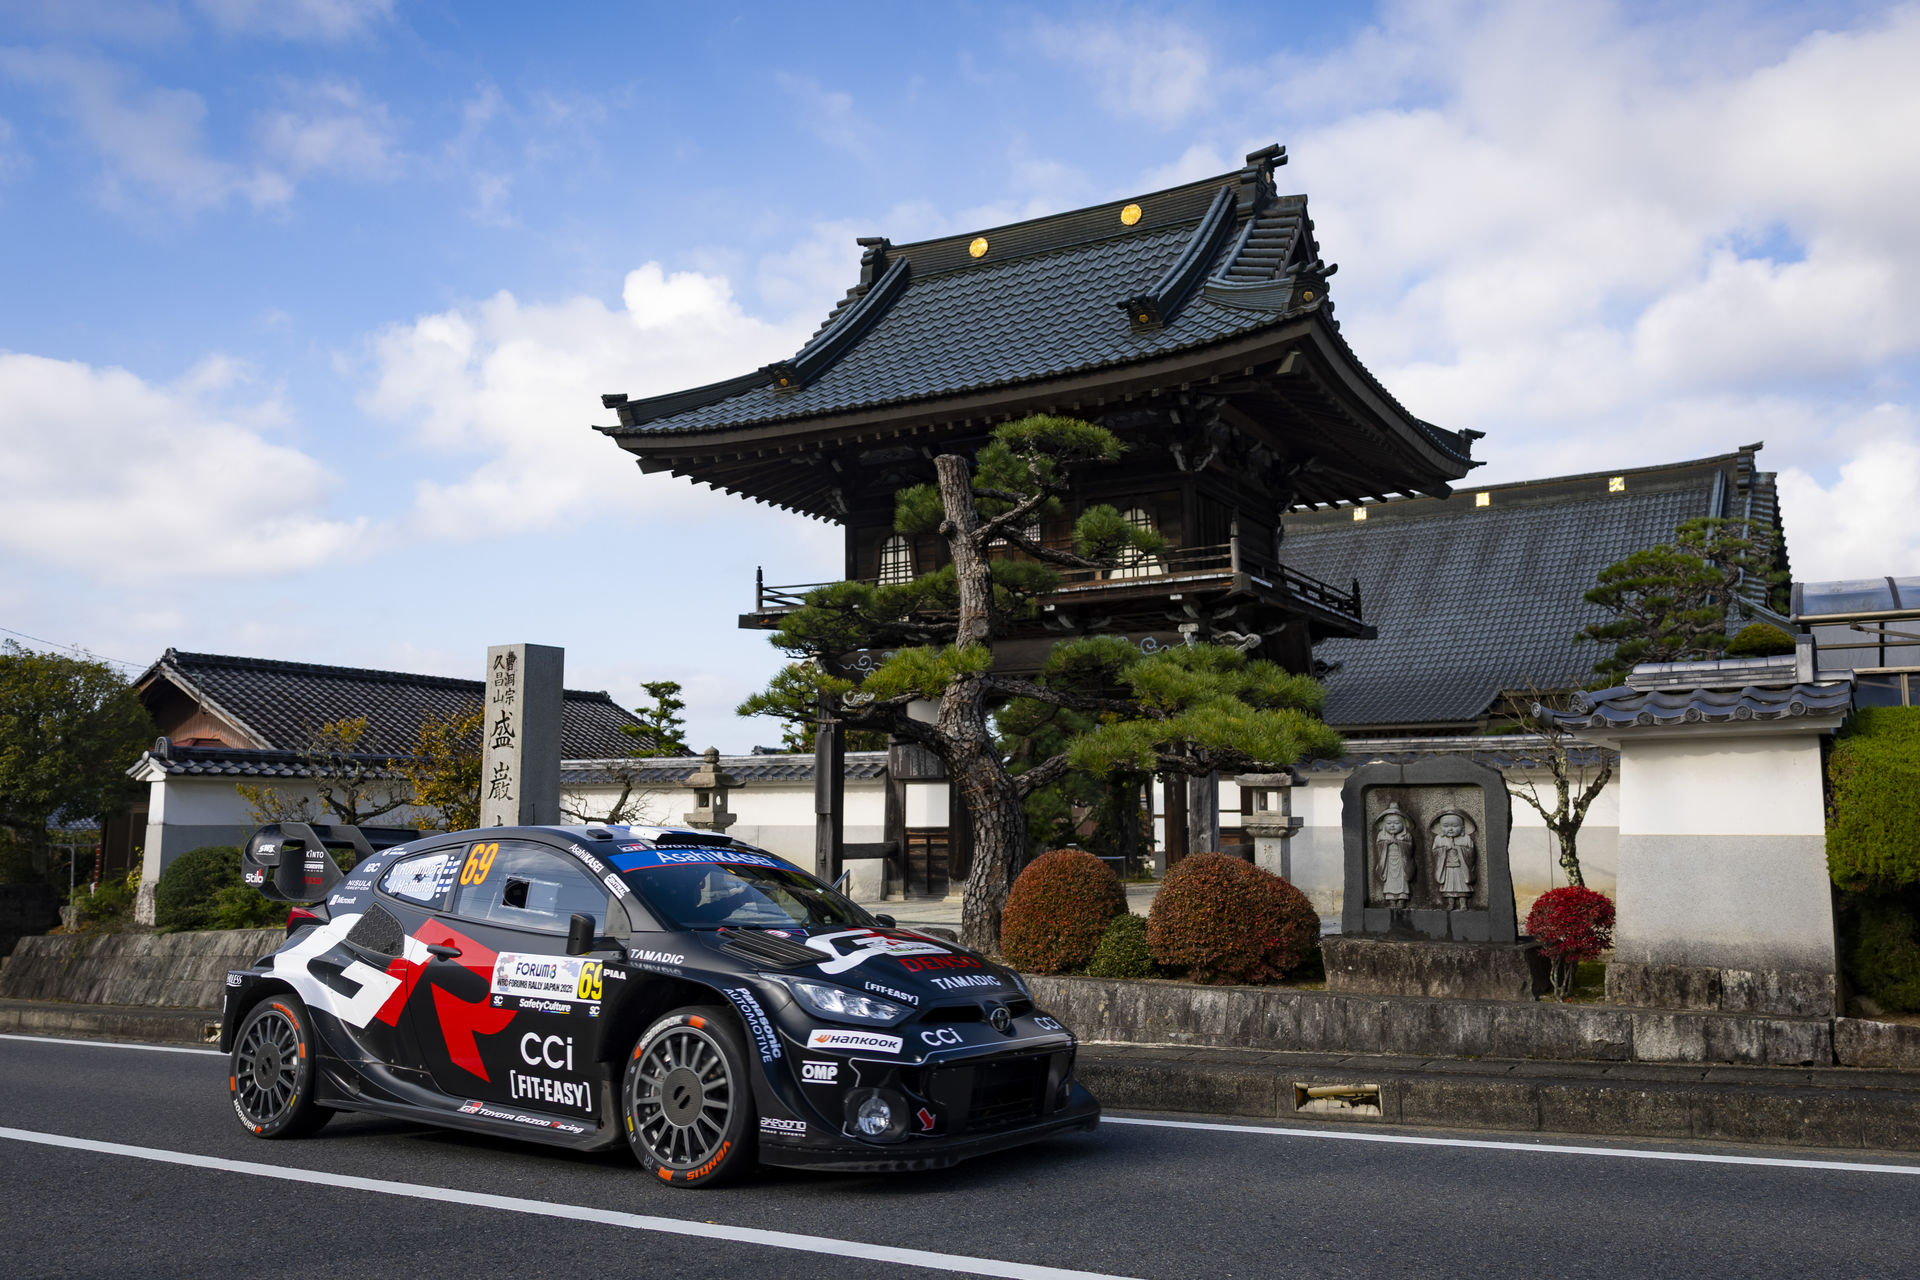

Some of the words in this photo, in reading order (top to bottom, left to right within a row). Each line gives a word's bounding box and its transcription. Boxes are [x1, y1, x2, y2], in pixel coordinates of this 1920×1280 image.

[493, 654, 505, 704] 久昌山
[504, 650, 517, 705] 曹洞宗
[460, 842, 499, 886] 69
[568, 843, 605, 874] AsahiKASEI
[656, 850, 778, 867] AsahiKASEI
[245, 868, 264, 884] Stilo
[630, 949, 685, 965] TAMADIC
[898, 955, 982, 973] DENSO
[516, 962, 557, 979] FORUM8
[603, 968, 627, 980] PIAA
[528, 980, 543, 990] RALLY
[543, 982, 560, 992] JAPAN
[578, 962, 603, 1000] 69
[931, 974, 1002, 990] TAMADIC
[519, 998, 572, 1012] SafetyCulture
[722, 988, 773, 1063] AUTOMOTIVE
[735, 987, 782, 1059] Panasonic
[920, 1027, 964, 1047] CCi
[520, 1031, 573, 1071] CCi
[802, 1064, 838, 1080] OMP
[479, 1108, 515, 1120] TOYOTA
[514, 1115, 551, 1126] GAZOO
[549, 1121, 585, 1134] Racing
[760, 1116, 807, 1130] akebono
